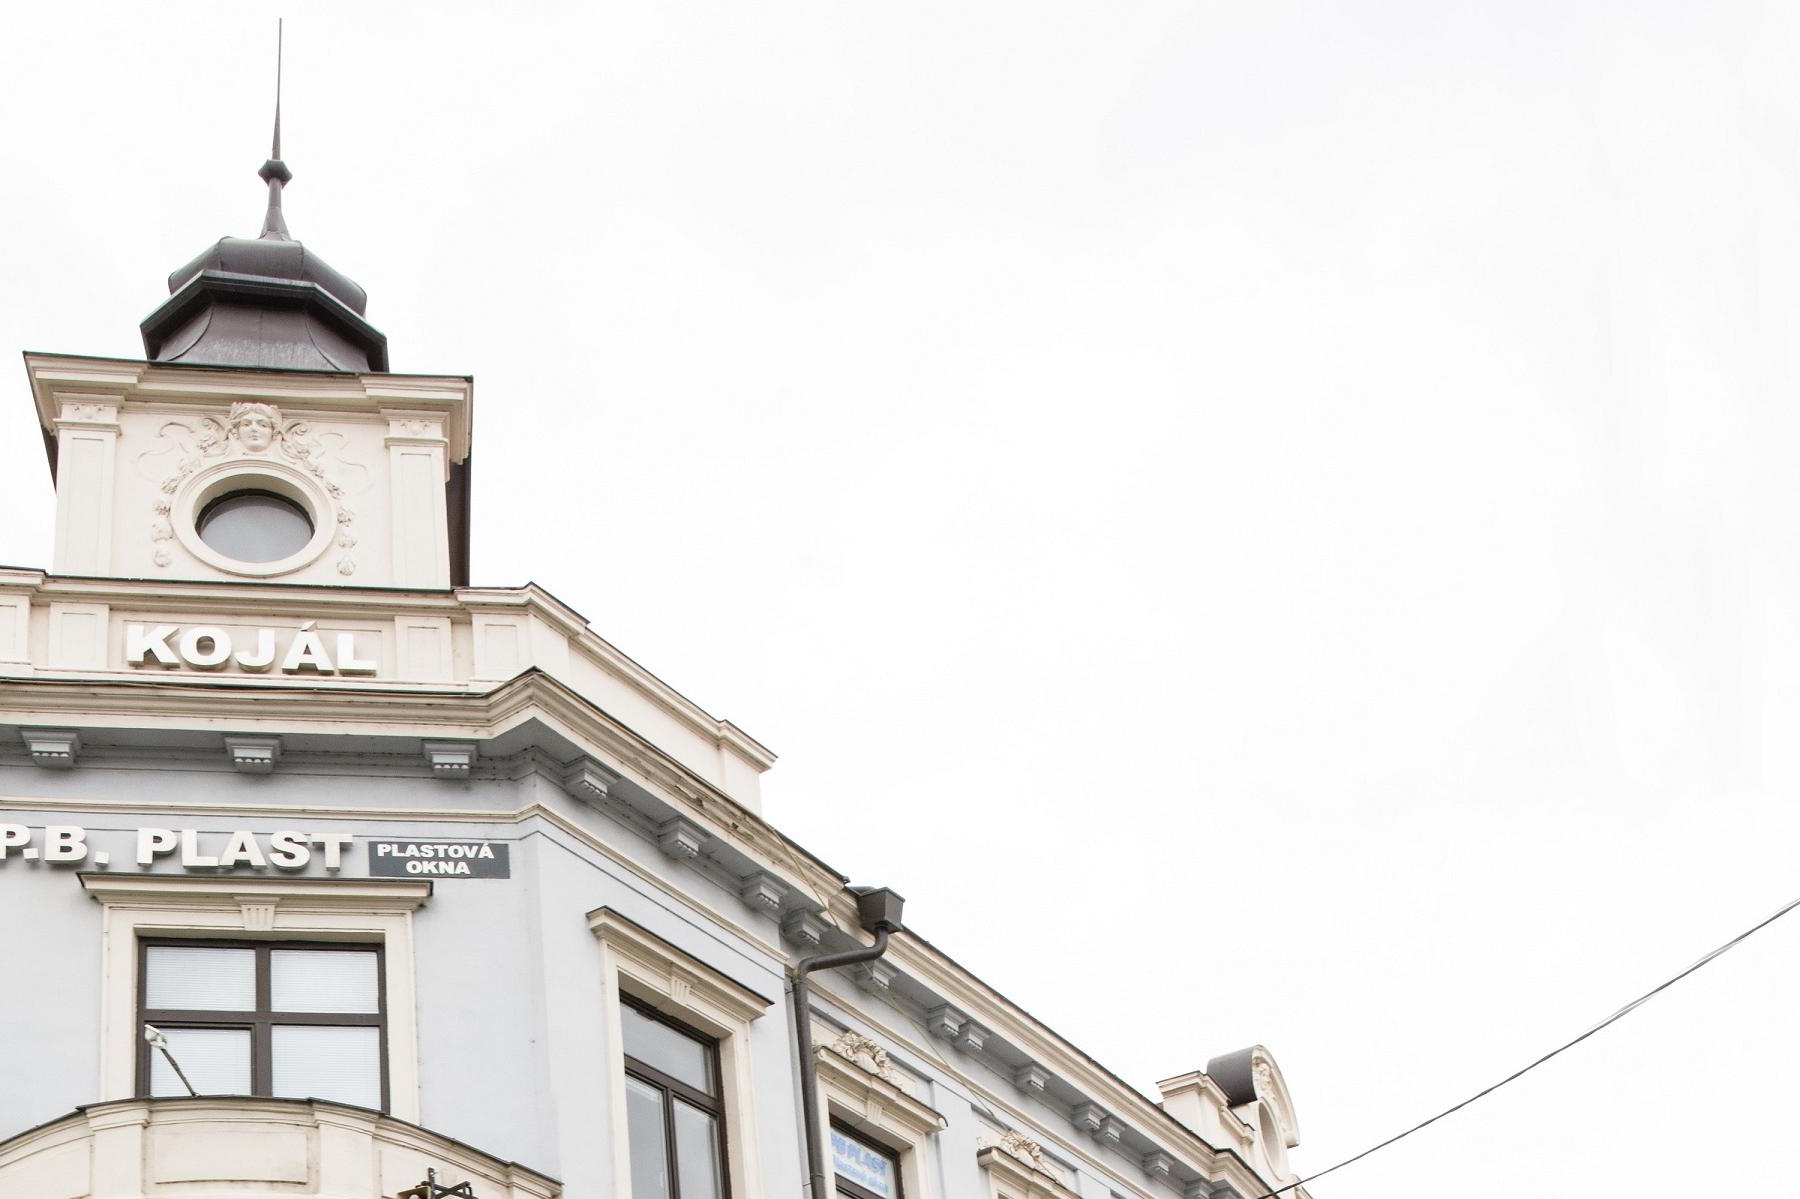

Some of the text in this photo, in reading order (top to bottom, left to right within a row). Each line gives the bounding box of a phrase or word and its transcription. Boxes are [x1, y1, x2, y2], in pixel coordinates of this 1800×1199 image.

[126, 620, 377, 677] KOJÁL
[136, 827, 354, 872] PLAST
[377, 842, 494, 860] PLASTOVÁ
[406, 861, 471, 875] OKNA
